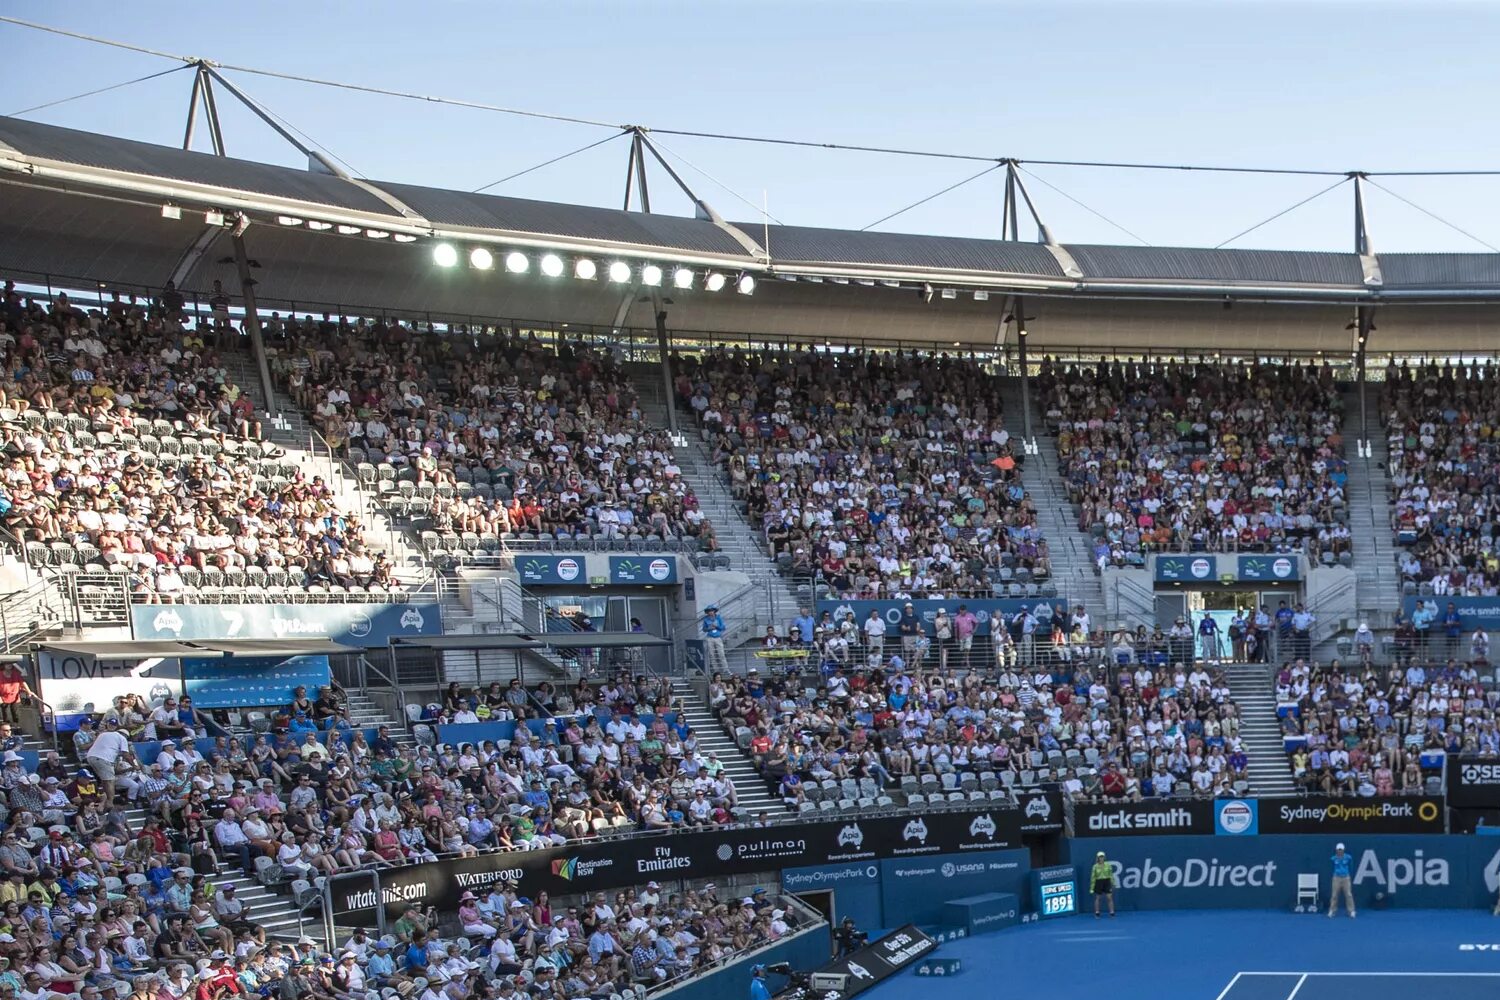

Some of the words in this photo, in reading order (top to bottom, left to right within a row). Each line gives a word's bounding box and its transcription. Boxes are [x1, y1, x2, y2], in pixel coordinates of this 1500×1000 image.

[152, 687, 169, 697] Apia
[1089, 811, 1132, 830] dick
[1135, 808, 1192, 829] smith
[1280, 803, 1413, 823] SydneyOlympicPark
[907, 825, 924, 834] Apia
[974, 821, 992, 830] Apia
[842, 831, 859, 840] Apia
[655, 846, 671, 857] Fly
[738, 838, 806, 853] pullman
[577, 857, 613, 869] Destination
[637, 857, 691, 873] Emirates
[956, 863, 984, 873] USANA
[989, 862, 1018, 870] Hisense
[455, 868, 524, 887] WATERFORD
[577, 867, 594, 876] NSW
[786, 868, 864, 884] SydneyOlympicPark
[1110, 858, 1277, 889] RaboDirect
[1353, 849, 1450, 893] Apia
[1045, 896, 1067, 912] 189
